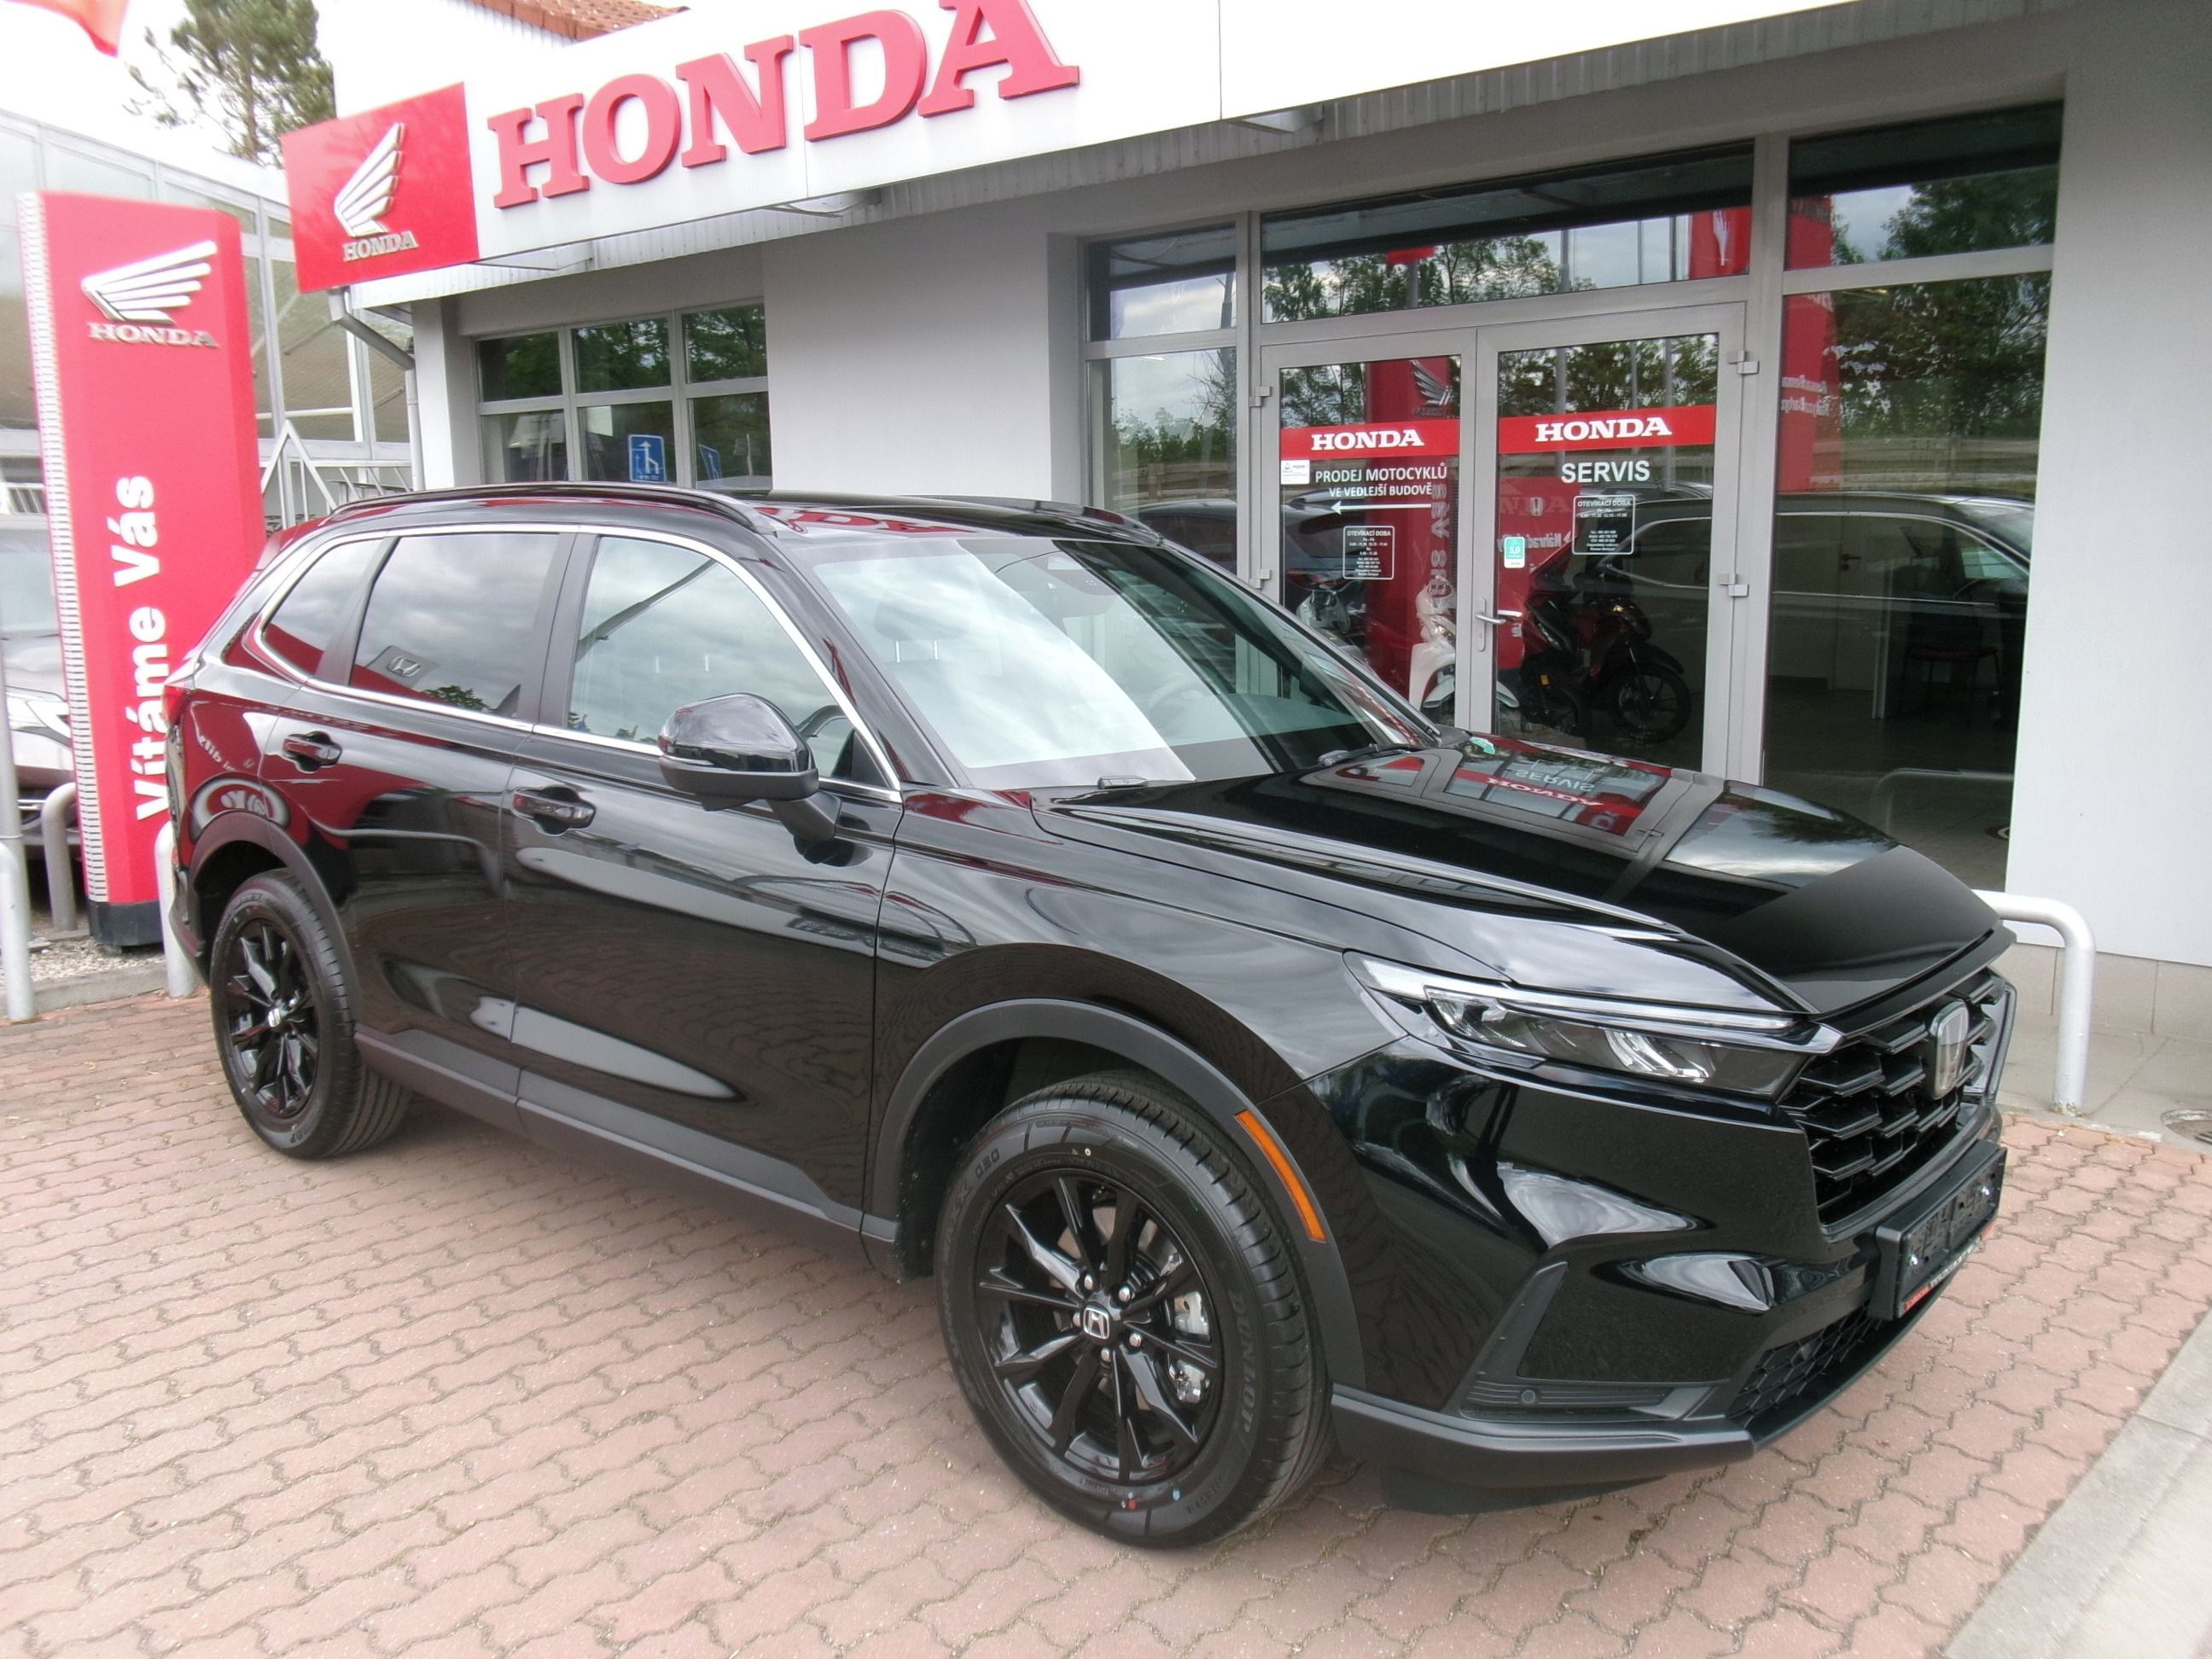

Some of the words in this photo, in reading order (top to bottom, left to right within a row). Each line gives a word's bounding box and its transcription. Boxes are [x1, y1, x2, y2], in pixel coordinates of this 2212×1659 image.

[487, 0, 1080, 209] HONDA
[343, 230, 419, 262] HONDA
[87, 322, 218, 348] HONDA
[1311, 428, 1424, 451] HONDA
[1534, 416, 1673, 443] HONDA
[1315, 469, 1362, 483] PRODEJ
[1365, 462, 1447, 481] MOTOCYKLŮ
[1561, 460, 1650, 484] SERVIS
[1329, 487, 1342, 498] VE
[1345, 483, 1387, 497] VEDLEJŠÍ
[1390, 482, 1432, 496] BUDOVĚ
[108, 474, 160, 587] Vás
[125, 606, 168, 822] Vítáme
